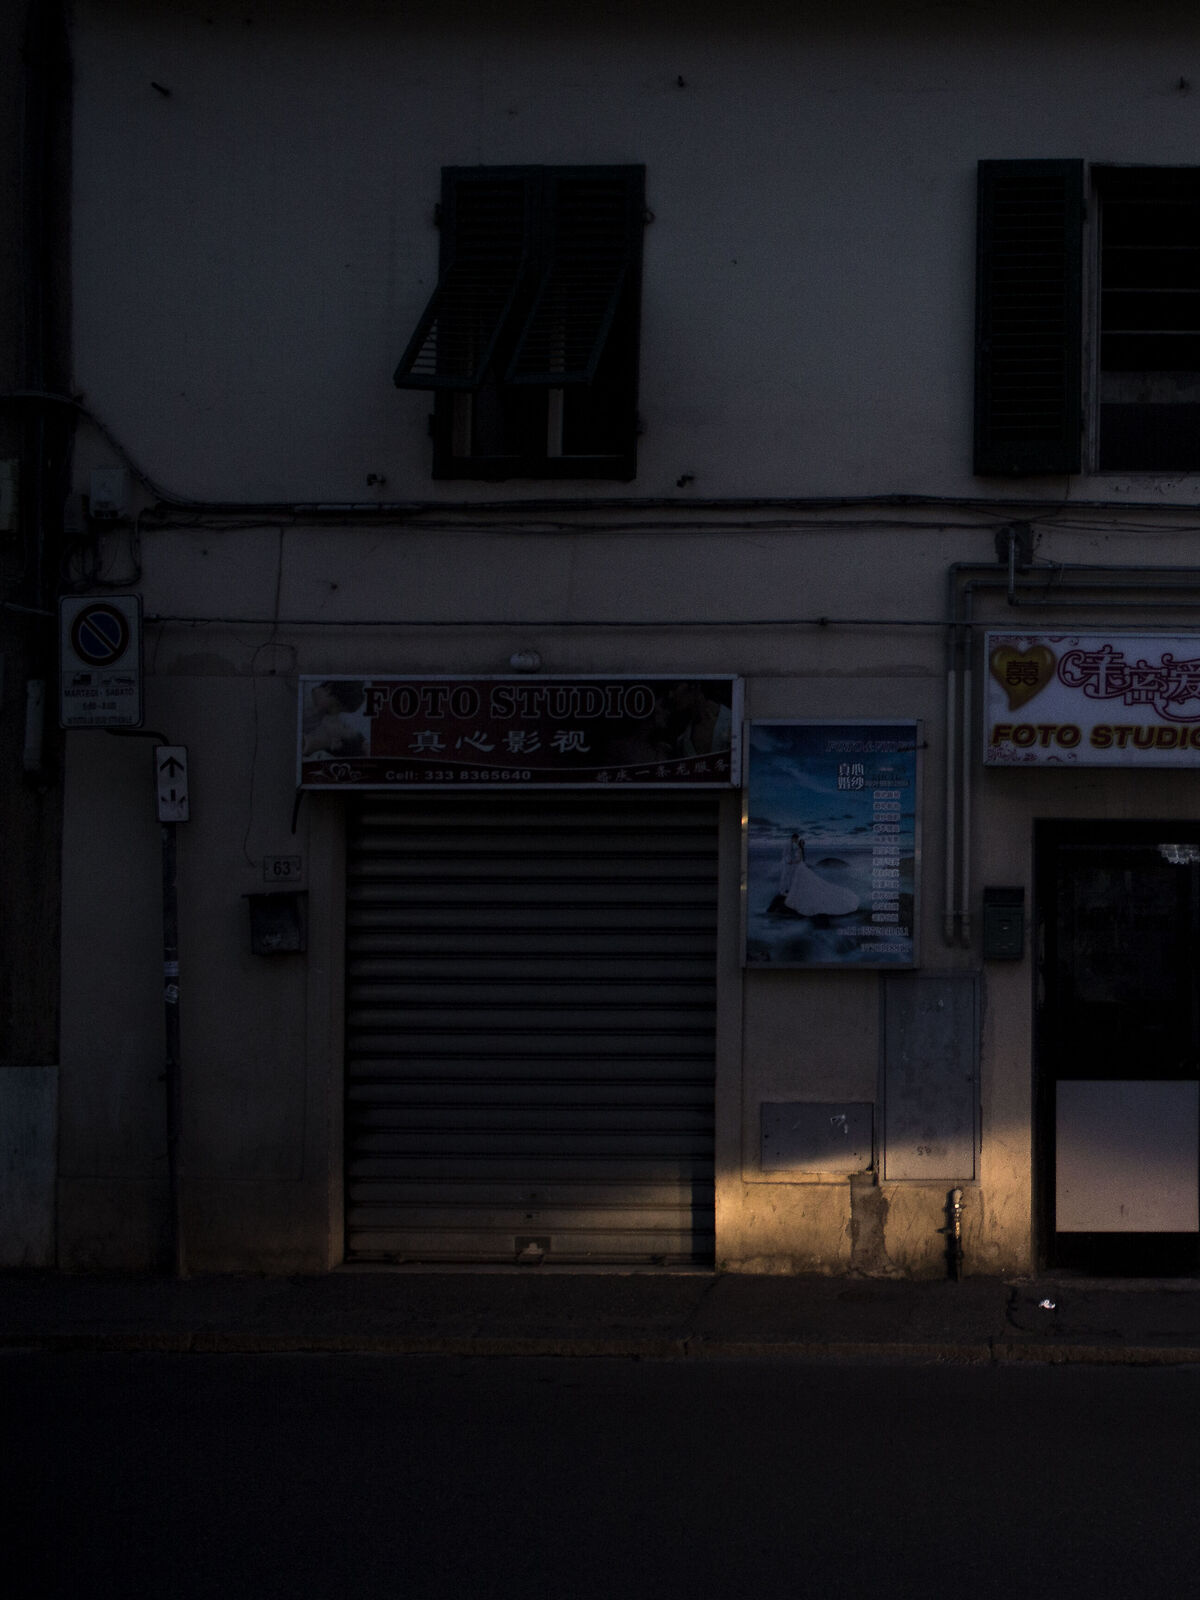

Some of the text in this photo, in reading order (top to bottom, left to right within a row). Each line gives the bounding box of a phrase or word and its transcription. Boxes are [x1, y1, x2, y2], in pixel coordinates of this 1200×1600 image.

[363, 684, 656, 721] FOTO STUDIO
[408, 728, 592, 755] 真心影视
[991, 723, 1081, 749] FOTO
[384, 768, 533, 783] Cell: 333 8365640
[273, 861, 291, 876] 63
